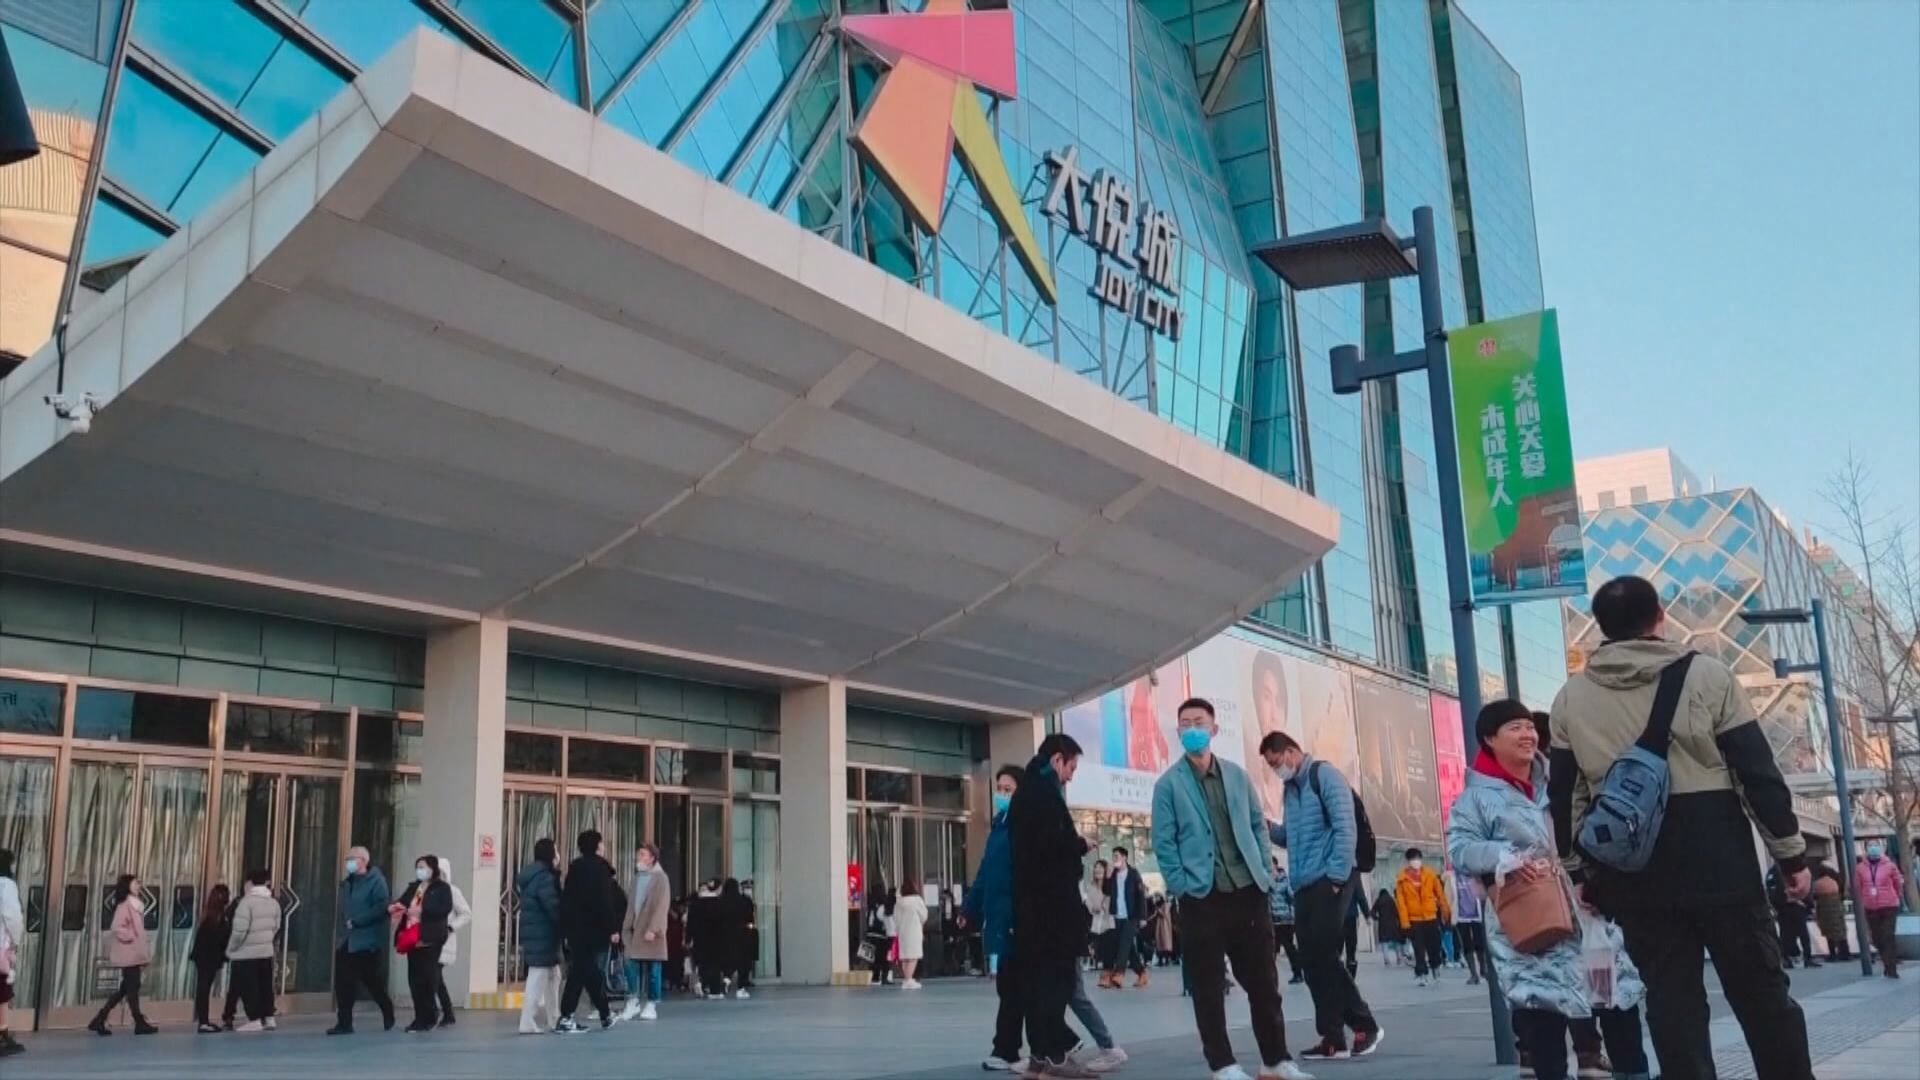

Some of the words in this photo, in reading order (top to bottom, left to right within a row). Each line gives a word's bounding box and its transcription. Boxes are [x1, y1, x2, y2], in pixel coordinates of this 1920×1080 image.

[1042, 144, 1180, 296] 大悦城
[1090, 263, 1137, 313] JOY
[1138, 291, 1185, 341] CITY
[1480, 404, 1513, 508] 未成年人
[1512, 373, 1546, 478] 关心关爱
